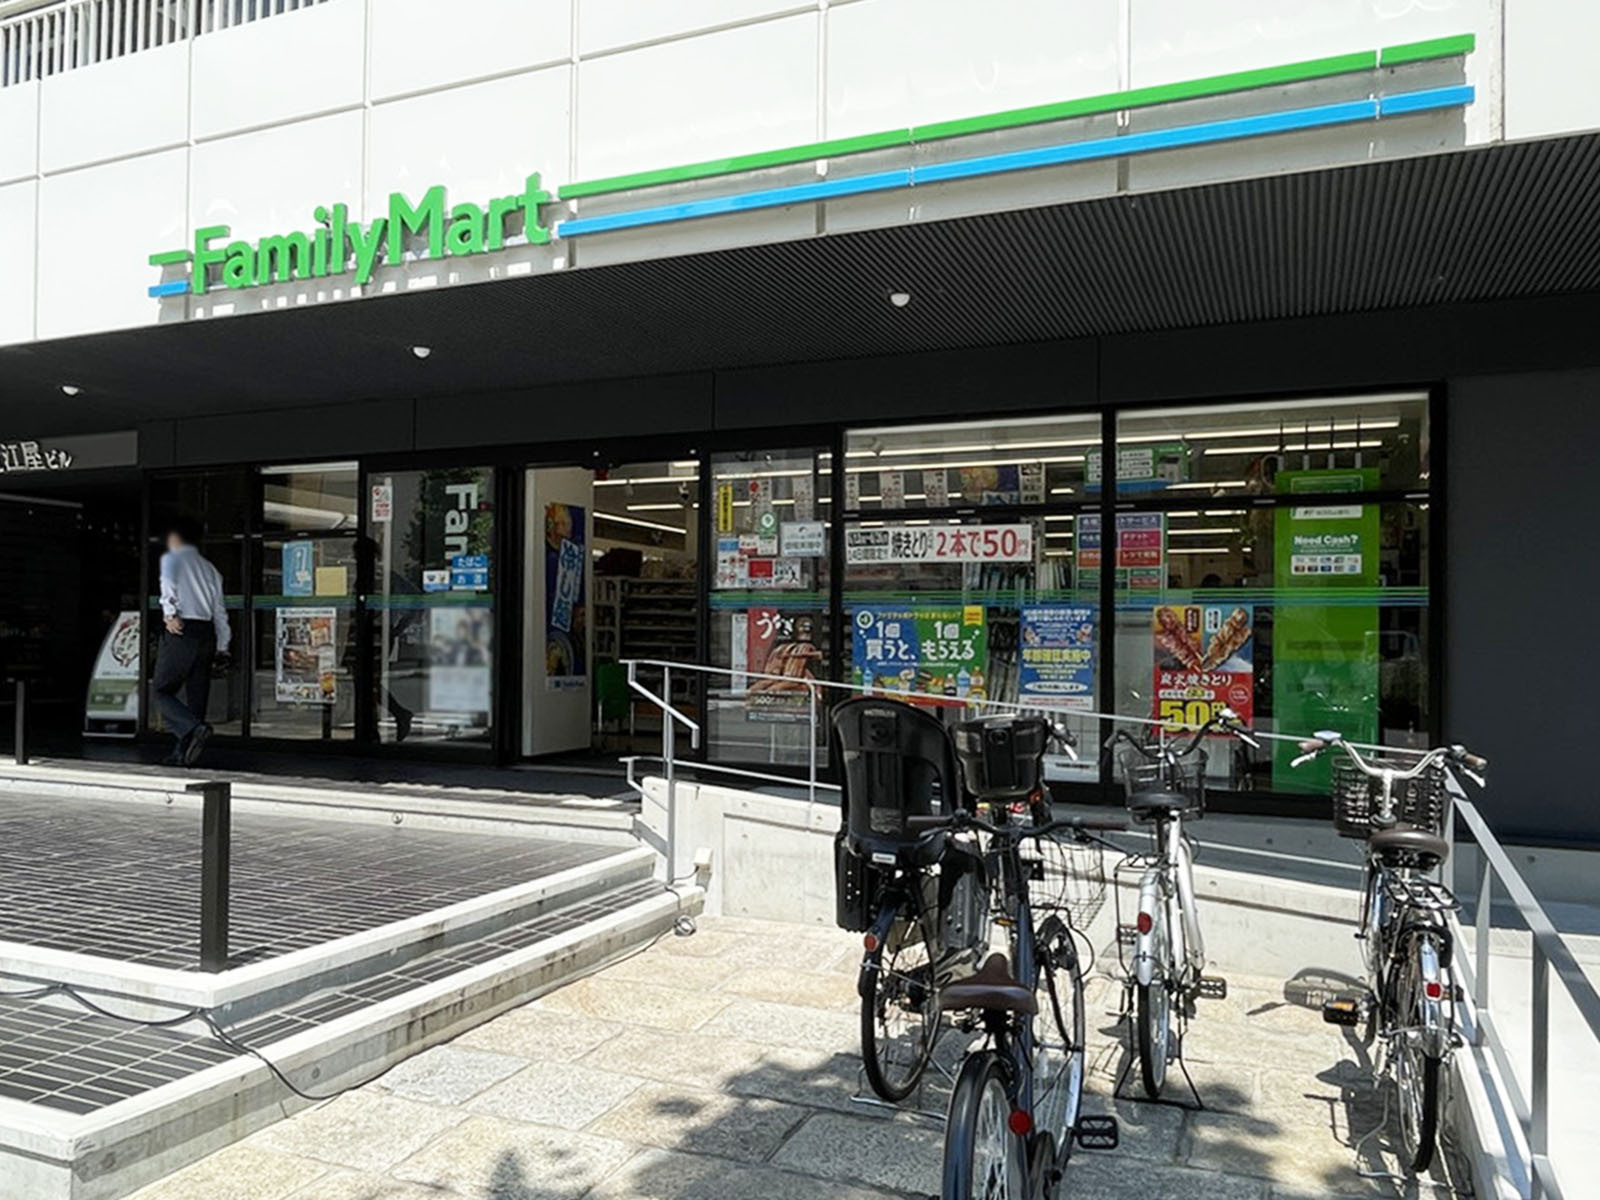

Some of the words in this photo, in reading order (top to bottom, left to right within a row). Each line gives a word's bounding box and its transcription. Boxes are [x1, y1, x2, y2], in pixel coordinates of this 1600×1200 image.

[193, 172, 550, 295] FamilyMart
[1294, 535, 1322, 545] Need
[1323, 534, 1359, 545] Cash?
[921, 639, 975, 660] もらえる
